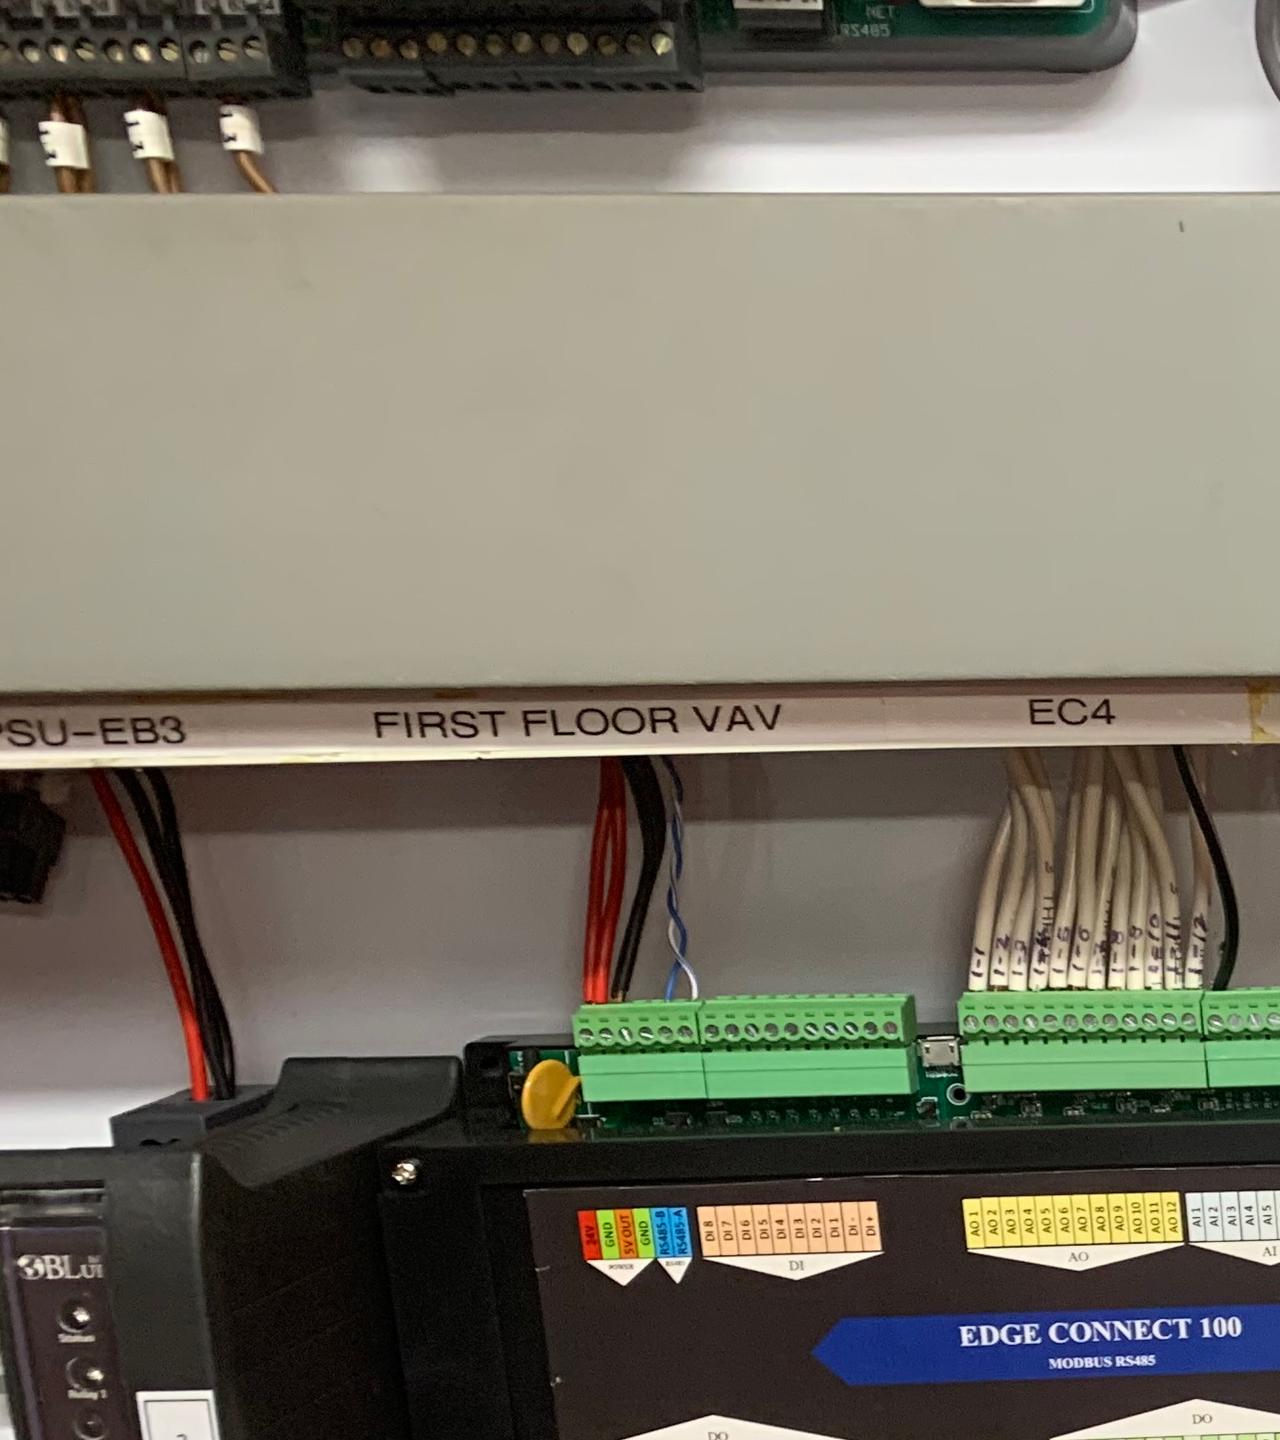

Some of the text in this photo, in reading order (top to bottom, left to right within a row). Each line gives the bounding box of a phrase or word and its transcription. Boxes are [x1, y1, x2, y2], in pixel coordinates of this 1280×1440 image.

[1028, 697, 1117, 727] EC4
[372, 703, 782, 739] FIRST FLOOR VAV
[0, 716, 187, 747] SU-EB3
[1069, 1252, 1089, 1262] AO
[1263, 1246, 1276, 1256] AI
[789, 1260, 804, 1271] DI
[959, 1317, 1241, 1346] EDGE CONNECT 100
[1049, 1355, 1156, 1369] MODBUS RS485
[1192, 1414, 1213, 1424] DO
